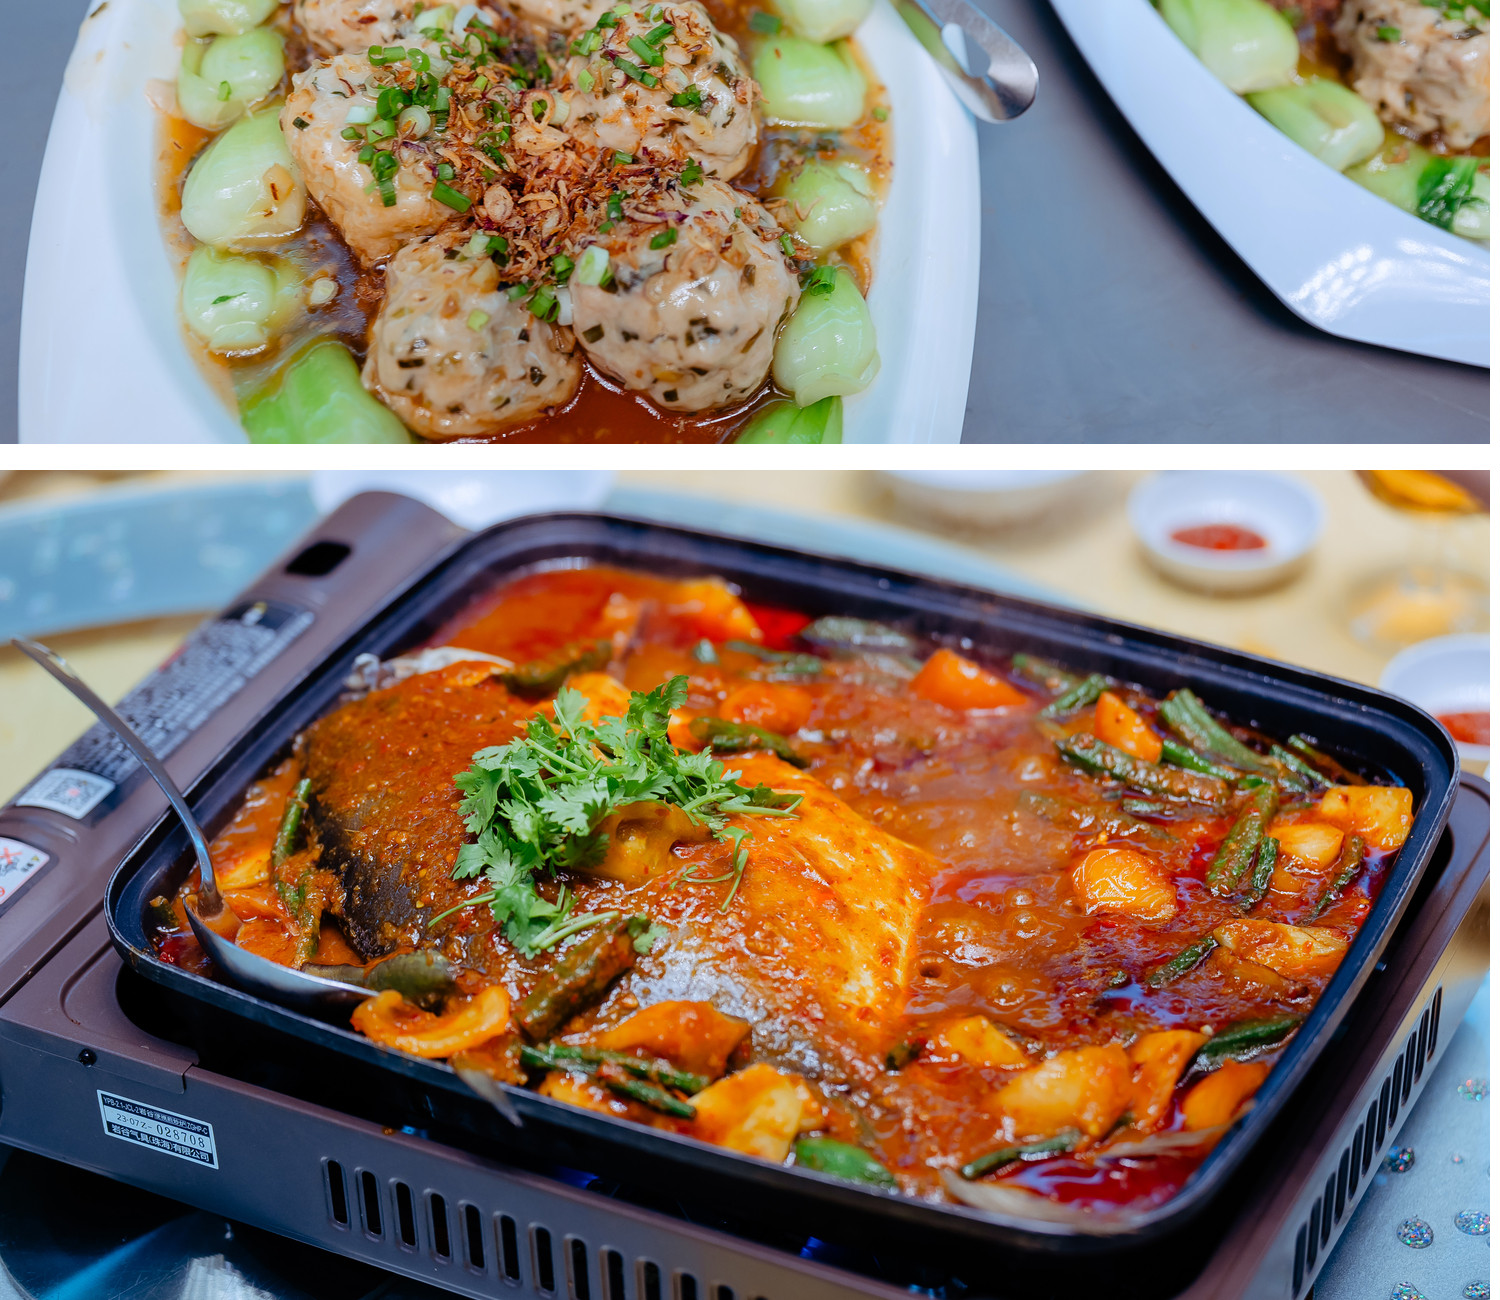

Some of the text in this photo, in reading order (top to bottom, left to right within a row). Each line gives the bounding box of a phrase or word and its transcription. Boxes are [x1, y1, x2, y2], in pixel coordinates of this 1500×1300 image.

[111, 1123, 210, 1162] 岩谷气具(珠海)有限公司
[156, 1124, 205, 1149] 028708
